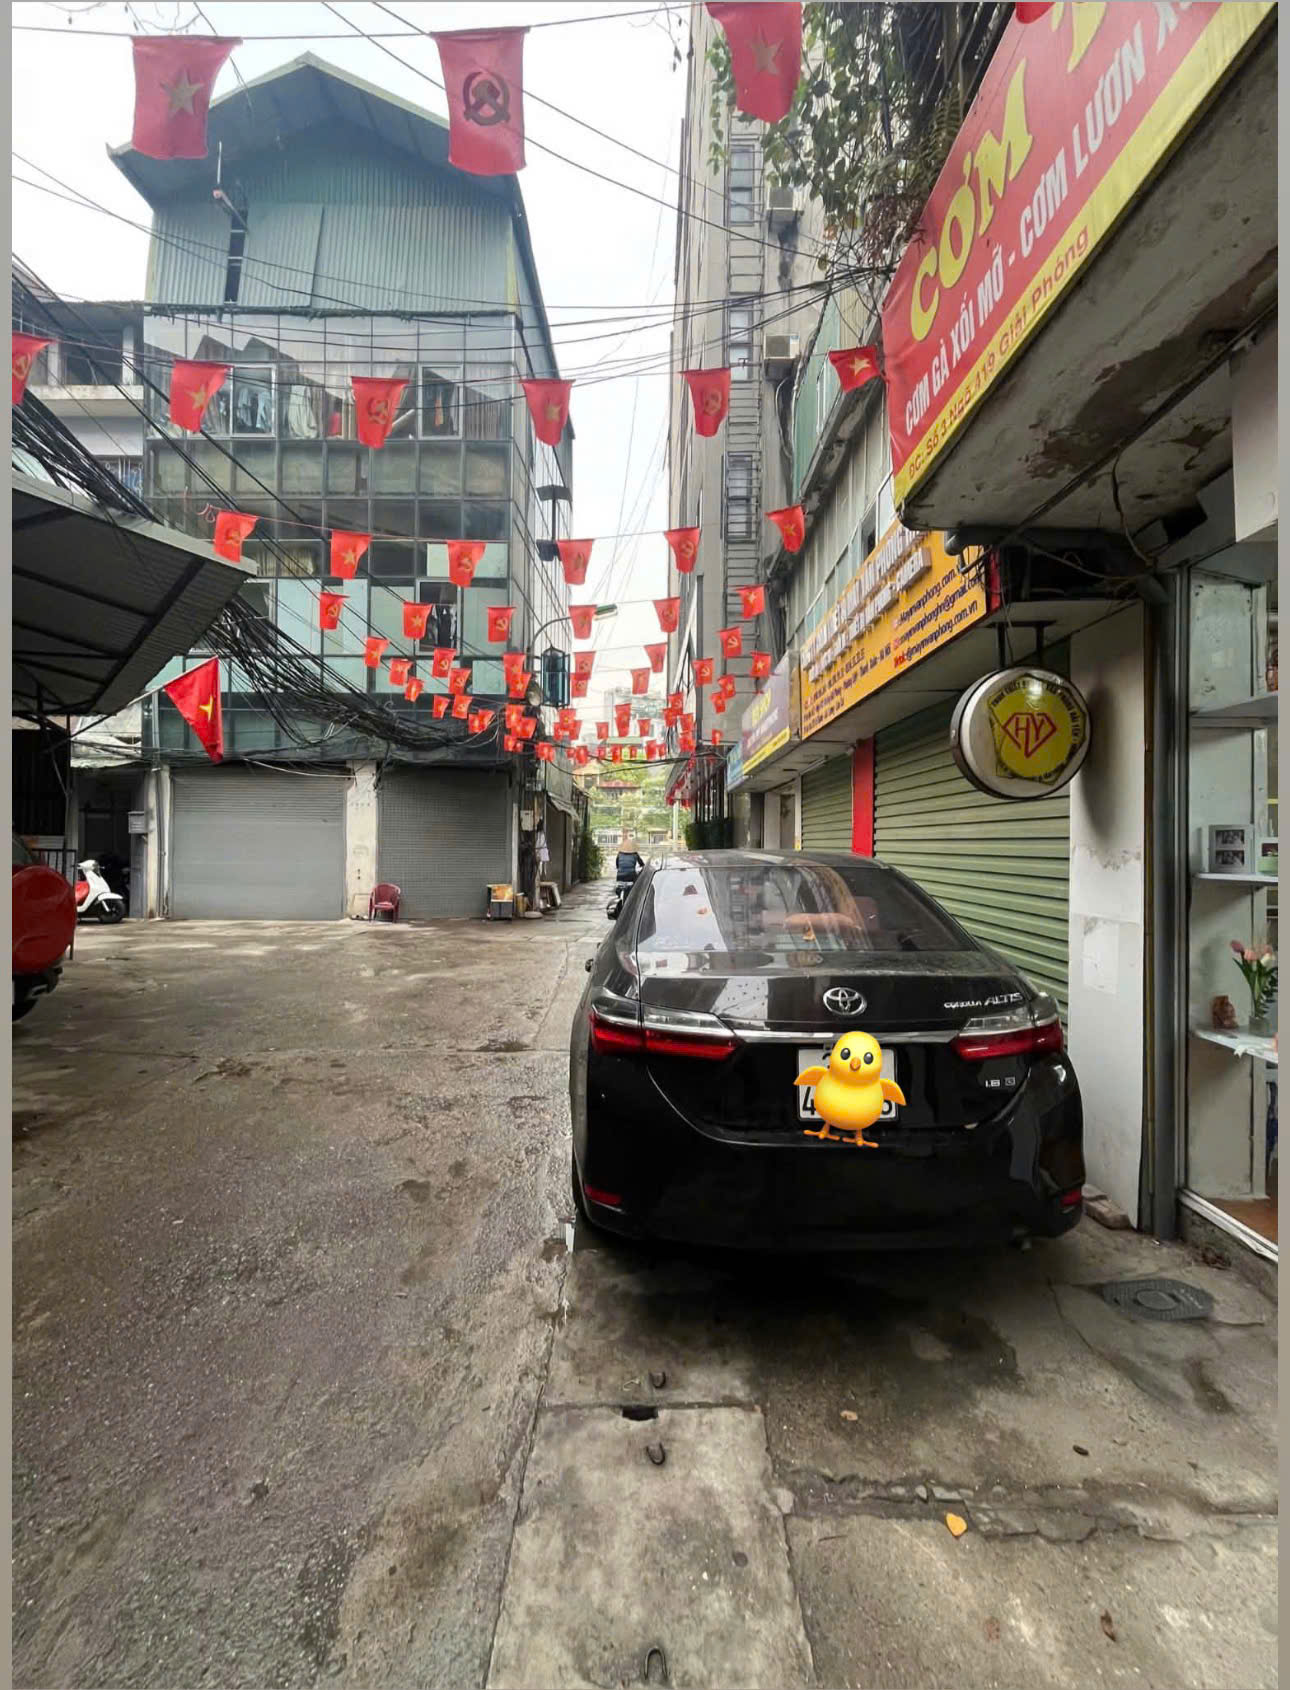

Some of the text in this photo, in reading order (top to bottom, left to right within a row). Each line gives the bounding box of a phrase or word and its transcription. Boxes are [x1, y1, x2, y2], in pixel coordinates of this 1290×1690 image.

[905, 372, 931, 437] CƠM
[931, 338, 950, 397] GÀ
[950, 291, 976, 369] XỐI
[977, 242, 1005, 328] MỠ
[1020, 146, 1068, 259] CƠM
[1072, 20, 1146, 180] LƯƠN
[911, 57, 1033, 342] CƠM
[1032, 225, 1088, 313] Phóng
[984, 992, 1023, 1006] ALTIS
